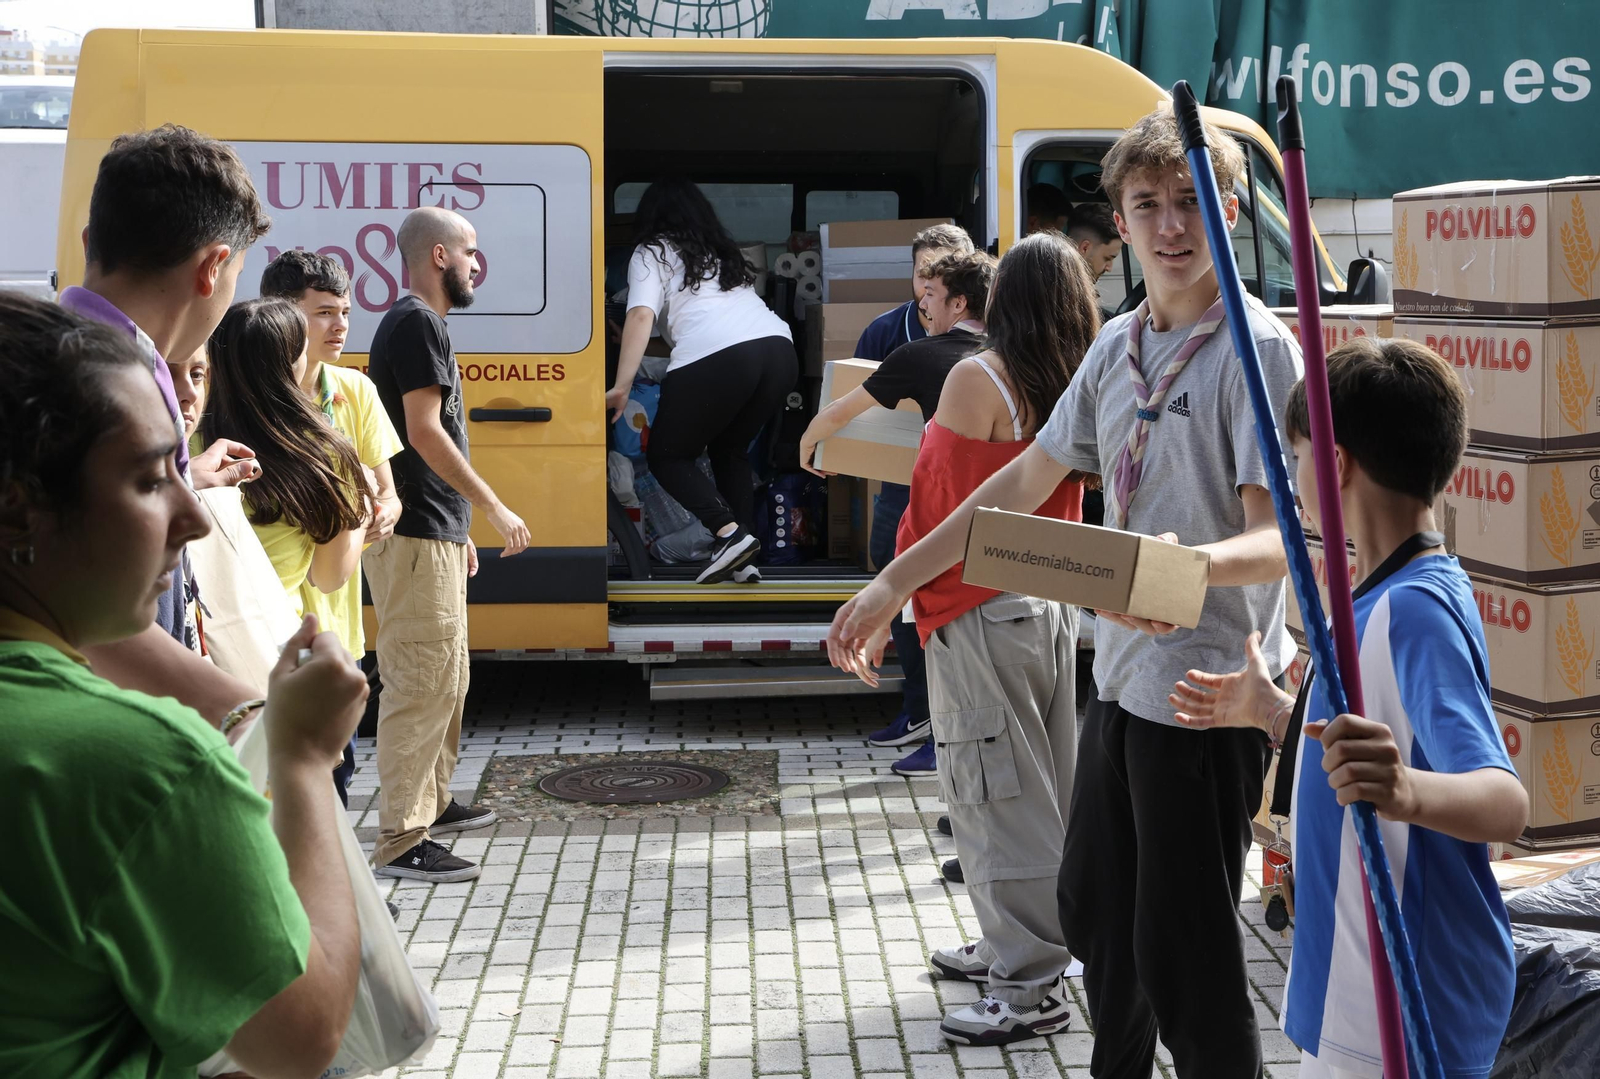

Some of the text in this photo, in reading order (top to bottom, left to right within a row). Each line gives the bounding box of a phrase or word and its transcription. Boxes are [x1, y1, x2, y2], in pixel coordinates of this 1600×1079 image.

[261, 161, 485, 211] UMIES
[1425, 203, 1537, 242] POLVILLO
[1394, 301, 1416, 312] Nuestro
[1415, 301, 1429, 312] buen
[1430, 304, 1441, 314] pan
[1441, 302, 1449, 312] de
[1167, 404, 1191, 418] adidas
[983, 545, 1115, 580] www.demialba.com
